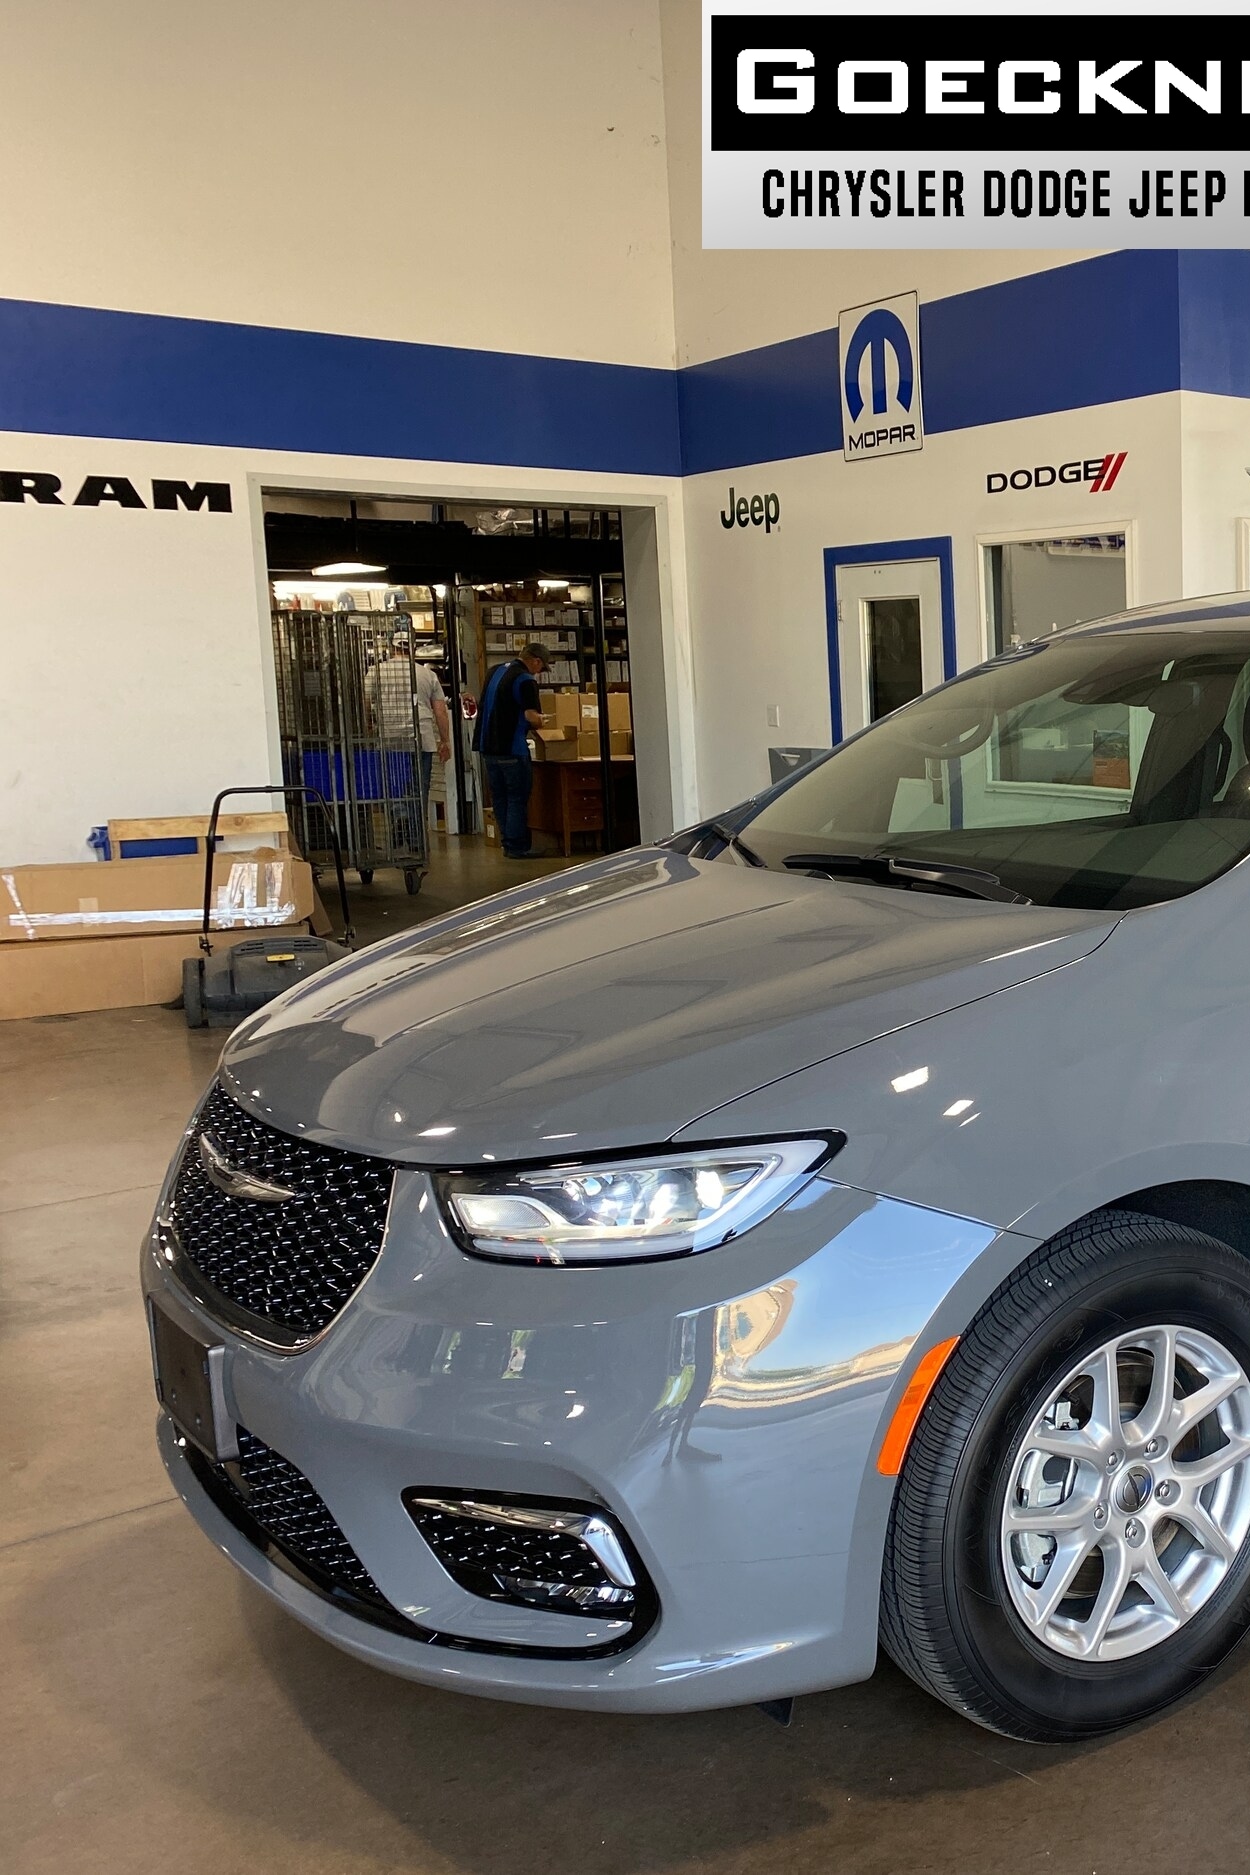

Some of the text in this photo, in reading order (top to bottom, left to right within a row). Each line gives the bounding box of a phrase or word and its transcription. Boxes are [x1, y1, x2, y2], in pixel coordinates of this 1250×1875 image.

[848, 424, 916, 452] MOPAR
[0, 470, 234, 513] RAM
[986, 458, 1107, 494] DODGE
[720, 487, 780, 533] Jeep
